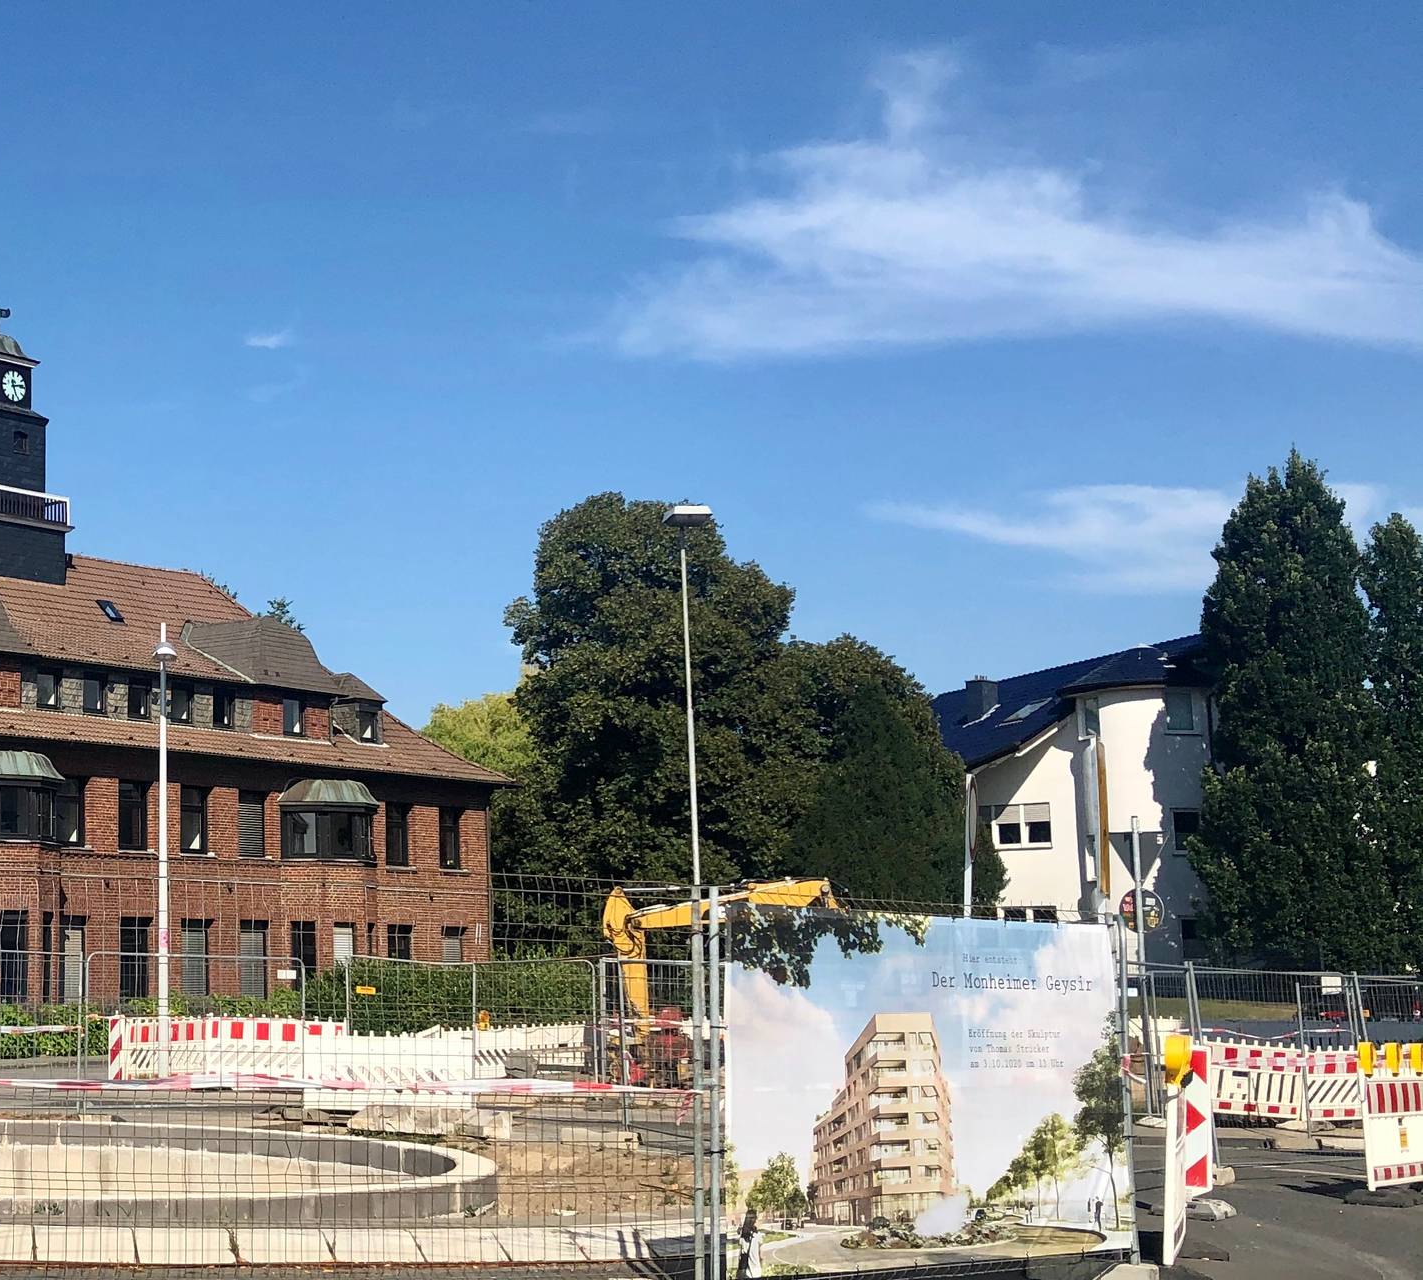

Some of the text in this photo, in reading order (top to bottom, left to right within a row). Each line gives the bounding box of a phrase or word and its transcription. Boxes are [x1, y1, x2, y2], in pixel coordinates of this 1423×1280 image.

[932, 972, 1093, 996] Der Monheimer Geysir
[968, 1028, 1007, 1040] Eröffnung
[1027, 1029, 1061, 1041] Skulptur
[986, 1044, 1012, 1053] Thomas
